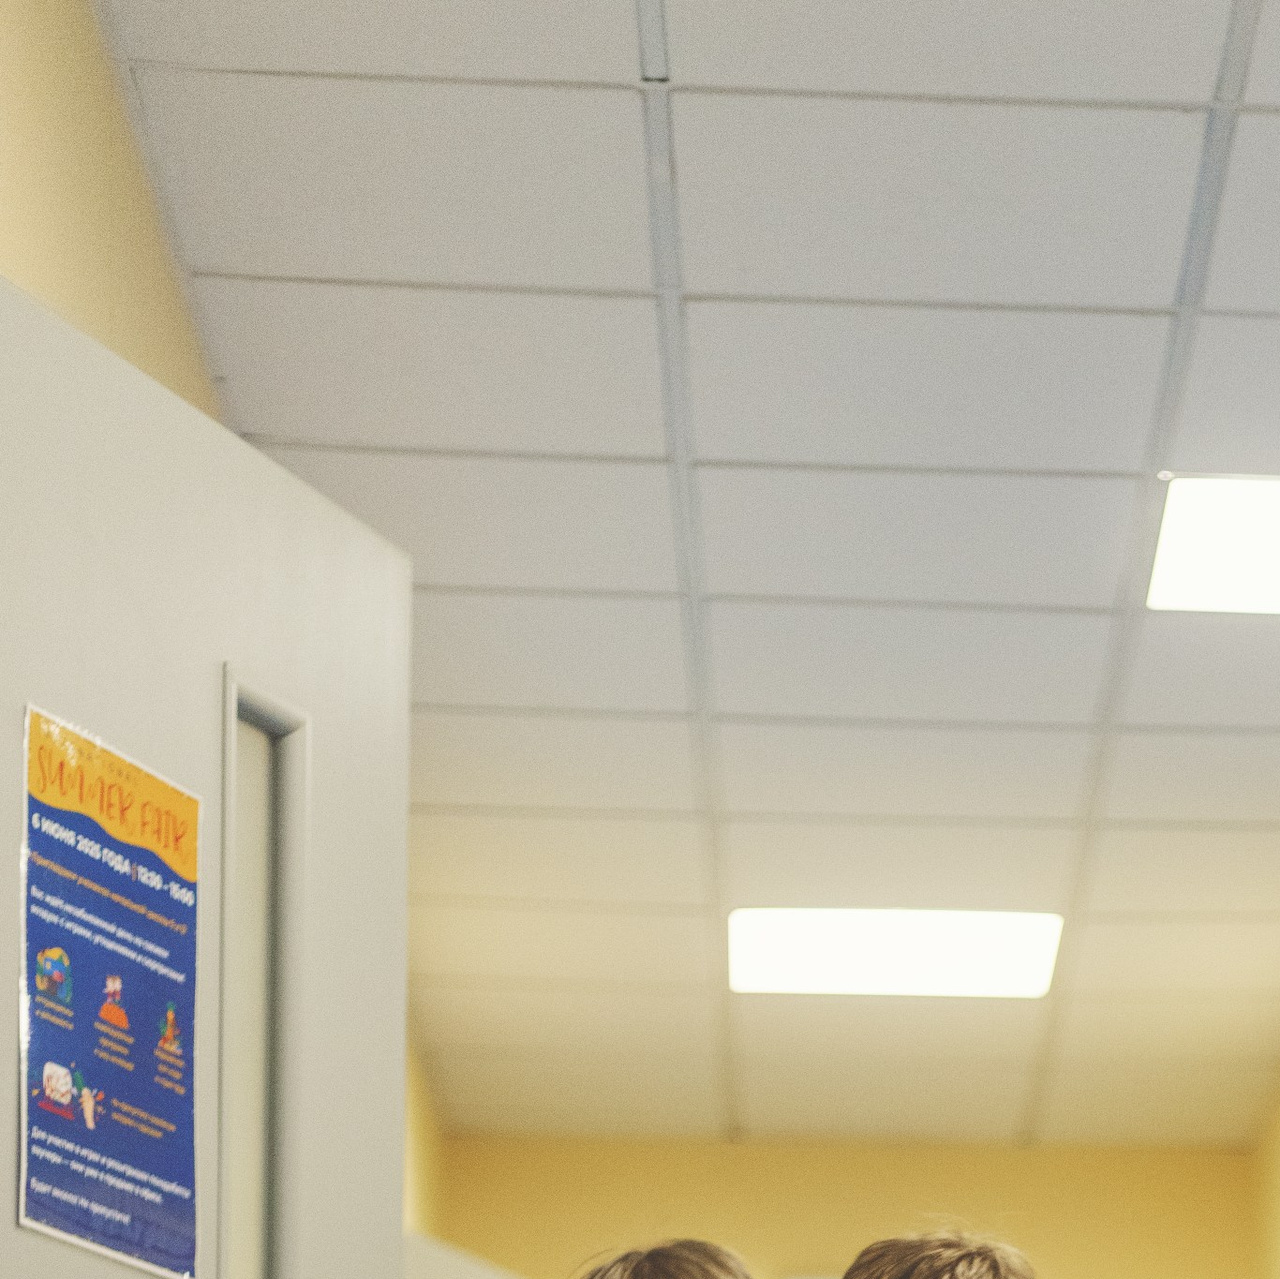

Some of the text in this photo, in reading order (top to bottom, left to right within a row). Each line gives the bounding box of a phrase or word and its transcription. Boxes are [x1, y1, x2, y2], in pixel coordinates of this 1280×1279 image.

[41, 816, 77, 847] ИЮНЯ
[102, 847, 132, 875] ГОДА
[139, 800, 189, 858] FAIR
